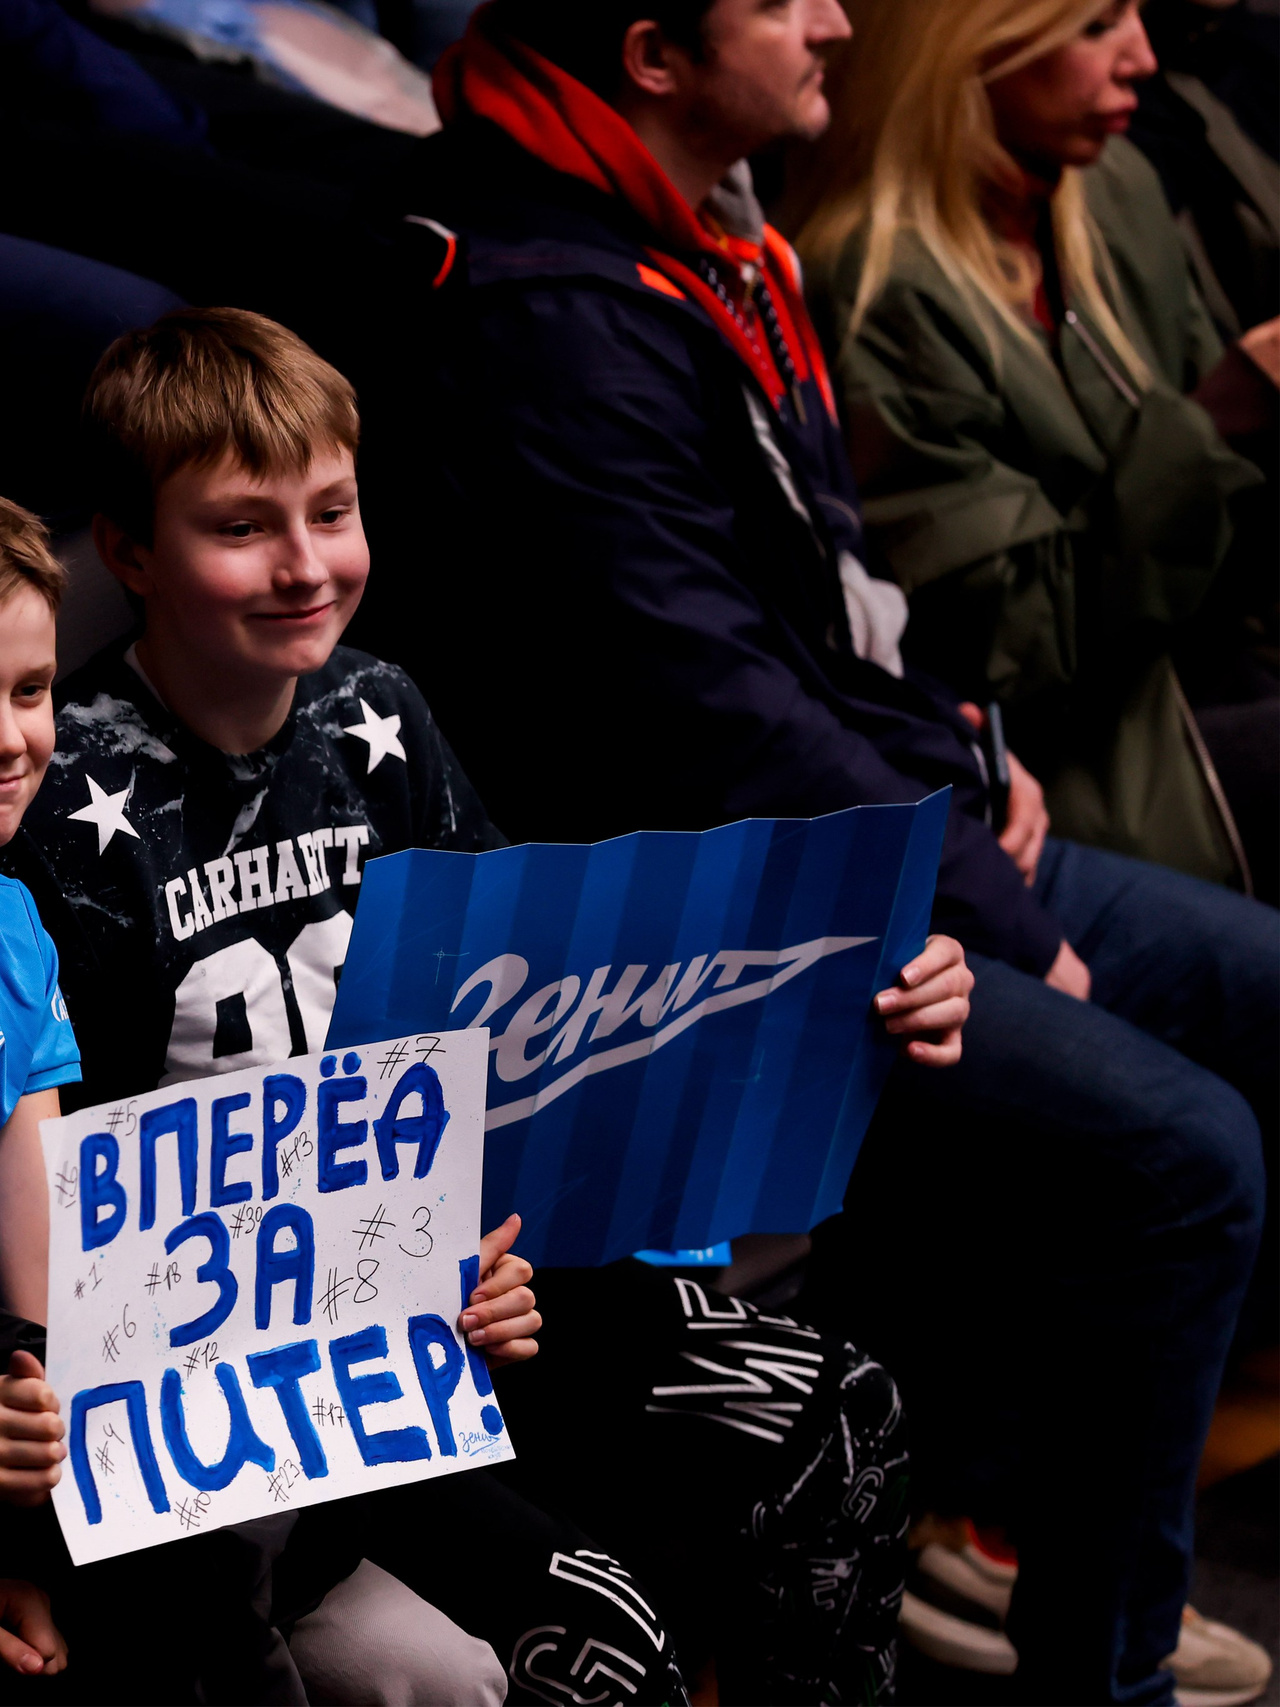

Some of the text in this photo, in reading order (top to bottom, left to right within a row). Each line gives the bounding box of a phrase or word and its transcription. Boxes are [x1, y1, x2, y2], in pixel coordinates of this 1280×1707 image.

[165, 825, 369, 942] CARHARTT
[376, 1036, 447, 1080] #7
[106, 1099, 138, 1136] #5
[165, 1203, 314, 1347] ЗА
[316, 1258, 380, 1325] #8
[102, 1303, 137, 1363] #6
[183, 1341, 220, 1380] #12
